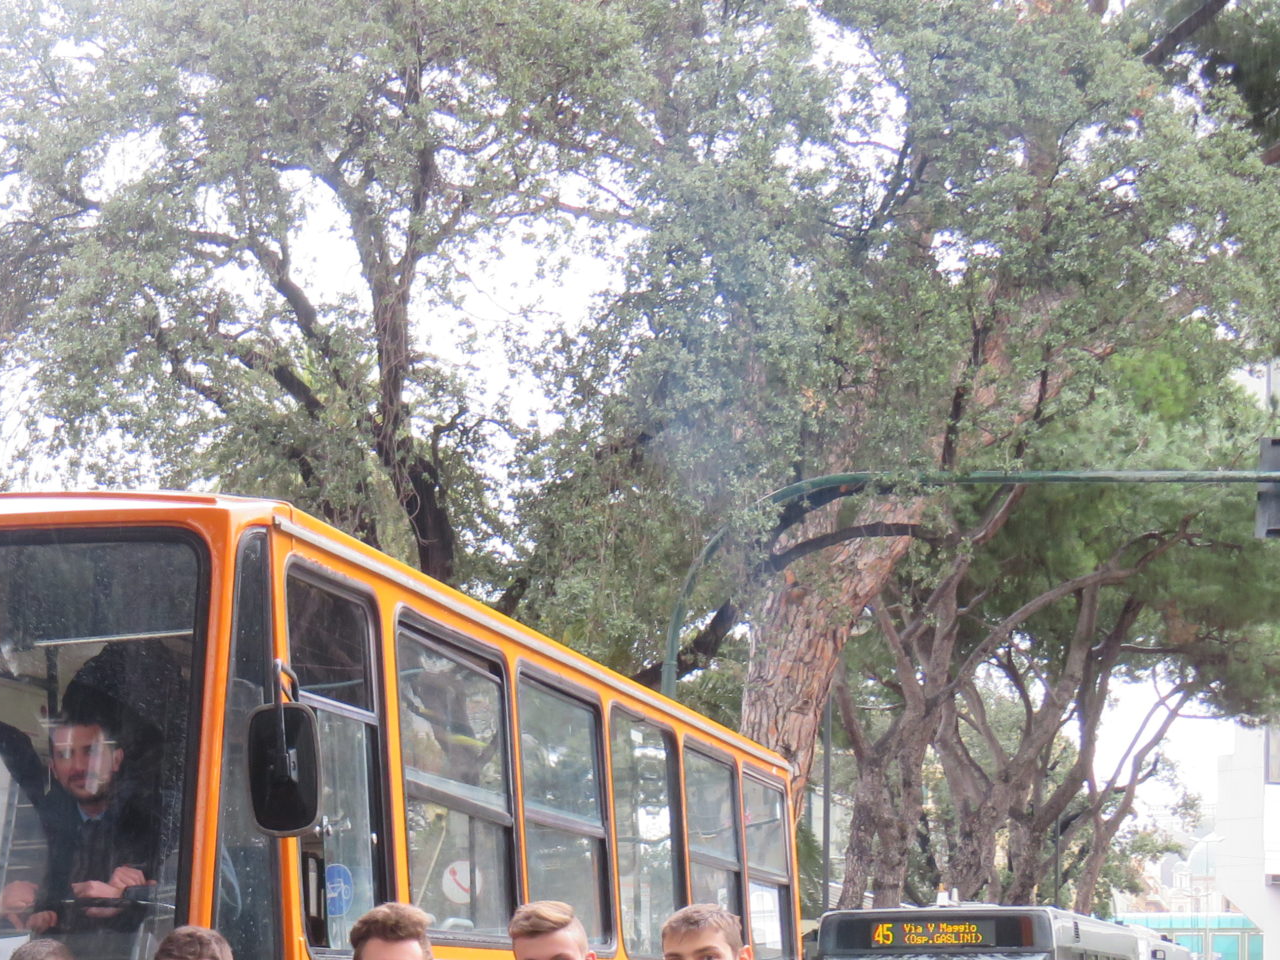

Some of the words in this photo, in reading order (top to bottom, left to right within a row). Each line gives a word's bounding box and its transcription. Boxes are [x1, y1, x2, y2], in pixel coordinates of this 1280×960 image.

[903, 923, 923, 933] Via
[927, 923, 935, 933] V
[939, 922, 977, 933] Maggio
[874, 923, 894, 944] 45
[904, 933, 983, 944] (Osp.GASLINI)
